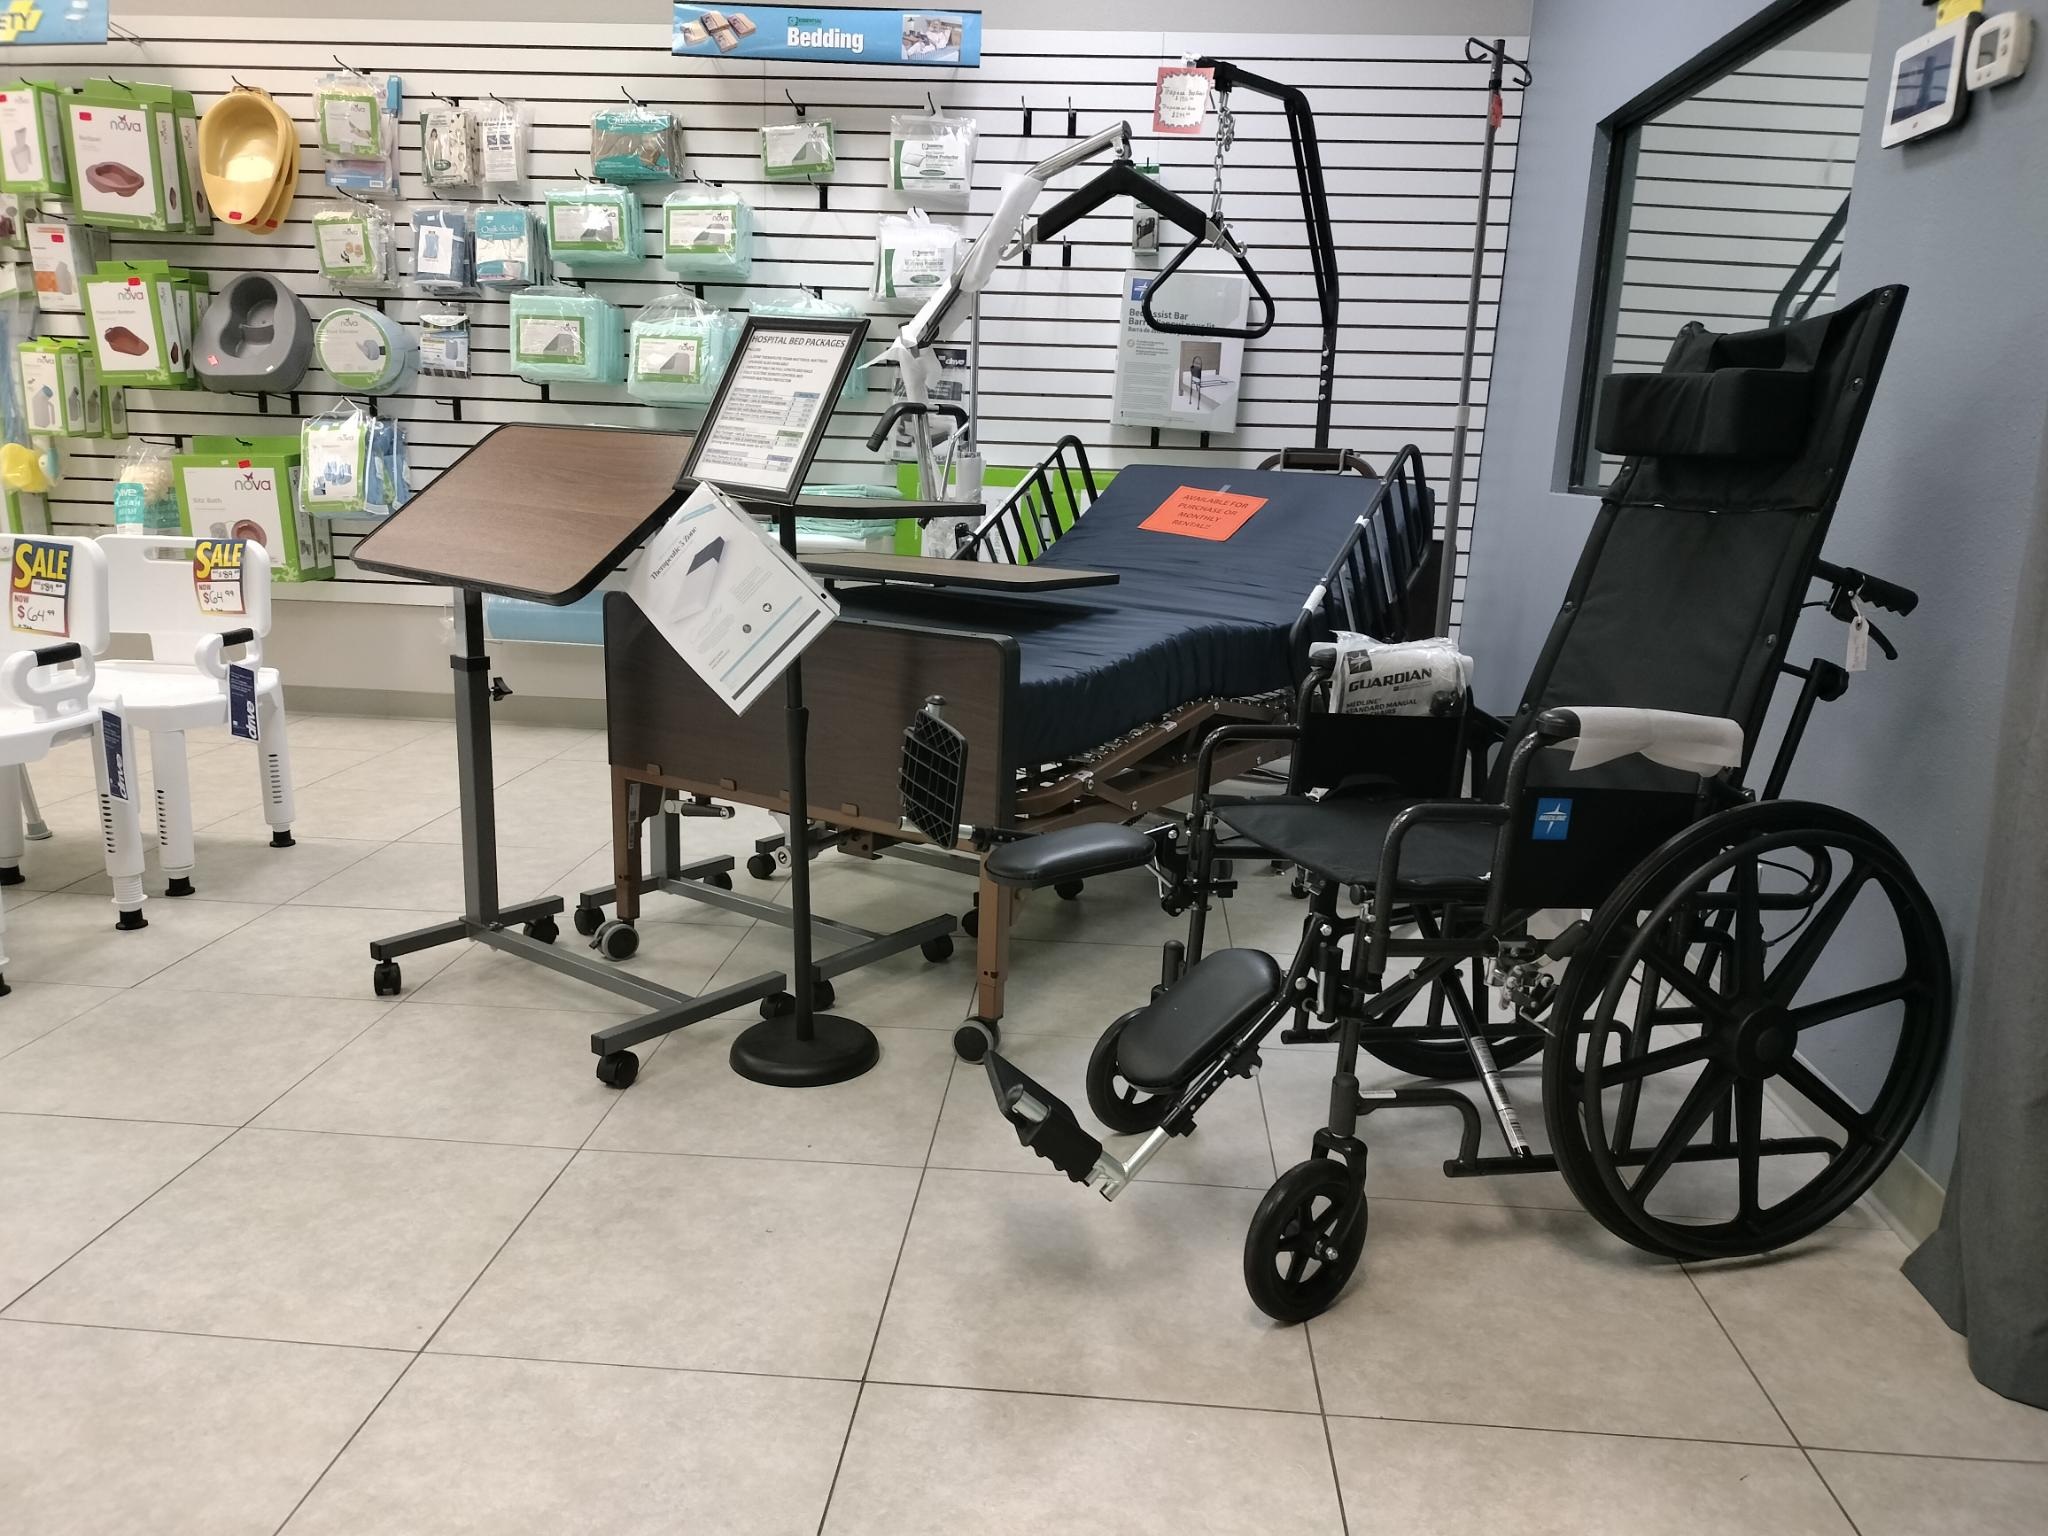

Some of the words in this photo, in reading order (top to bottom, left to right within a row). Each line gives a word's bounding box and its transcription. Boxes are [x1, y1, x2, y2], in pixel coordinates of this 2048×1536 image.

[787, 27, 864, 54] Bedding
[110, 117, 141, 133] nova
[712, 213, 729, 222] nova
[118, 289, 144, 301] nova
[1152, 309, 1172, 320] ssist
[1174, 311, 1188, 320] Bar
[341, 320, 358, 328] nova
[679, 343, 695, 351] nova
[751, 335, 788, 345] HOSPITAL
[789, 336, 805, 346] BED
[805, 338, 847, 348] PACKAGES
[235, 478, 271, 492] nova
[1183, 494, 1228, 507] AVAILABLE
[1229, 501, 1249, 509] FOR
[1178, 502, 1222, 515] PURCHASE
[1178, 511, 1222, 523] MONTHLY
[650, 542, 681, 581] Therapeutic
[684, 526, 697, 543] Zone
[14, 542, 71, 589] SALE
[195, 541, 243, 580] SALE
[14, 594, 29, 604] NOW
[1348, 667, 1432, 693] GUARDIAN
[1346, 698, 1379, 708] MEDLINE
[1386, 699, 1418, 709] MANUAL
[246, 700, 257, 740] drive
[116, 753, 128, 800] drive
